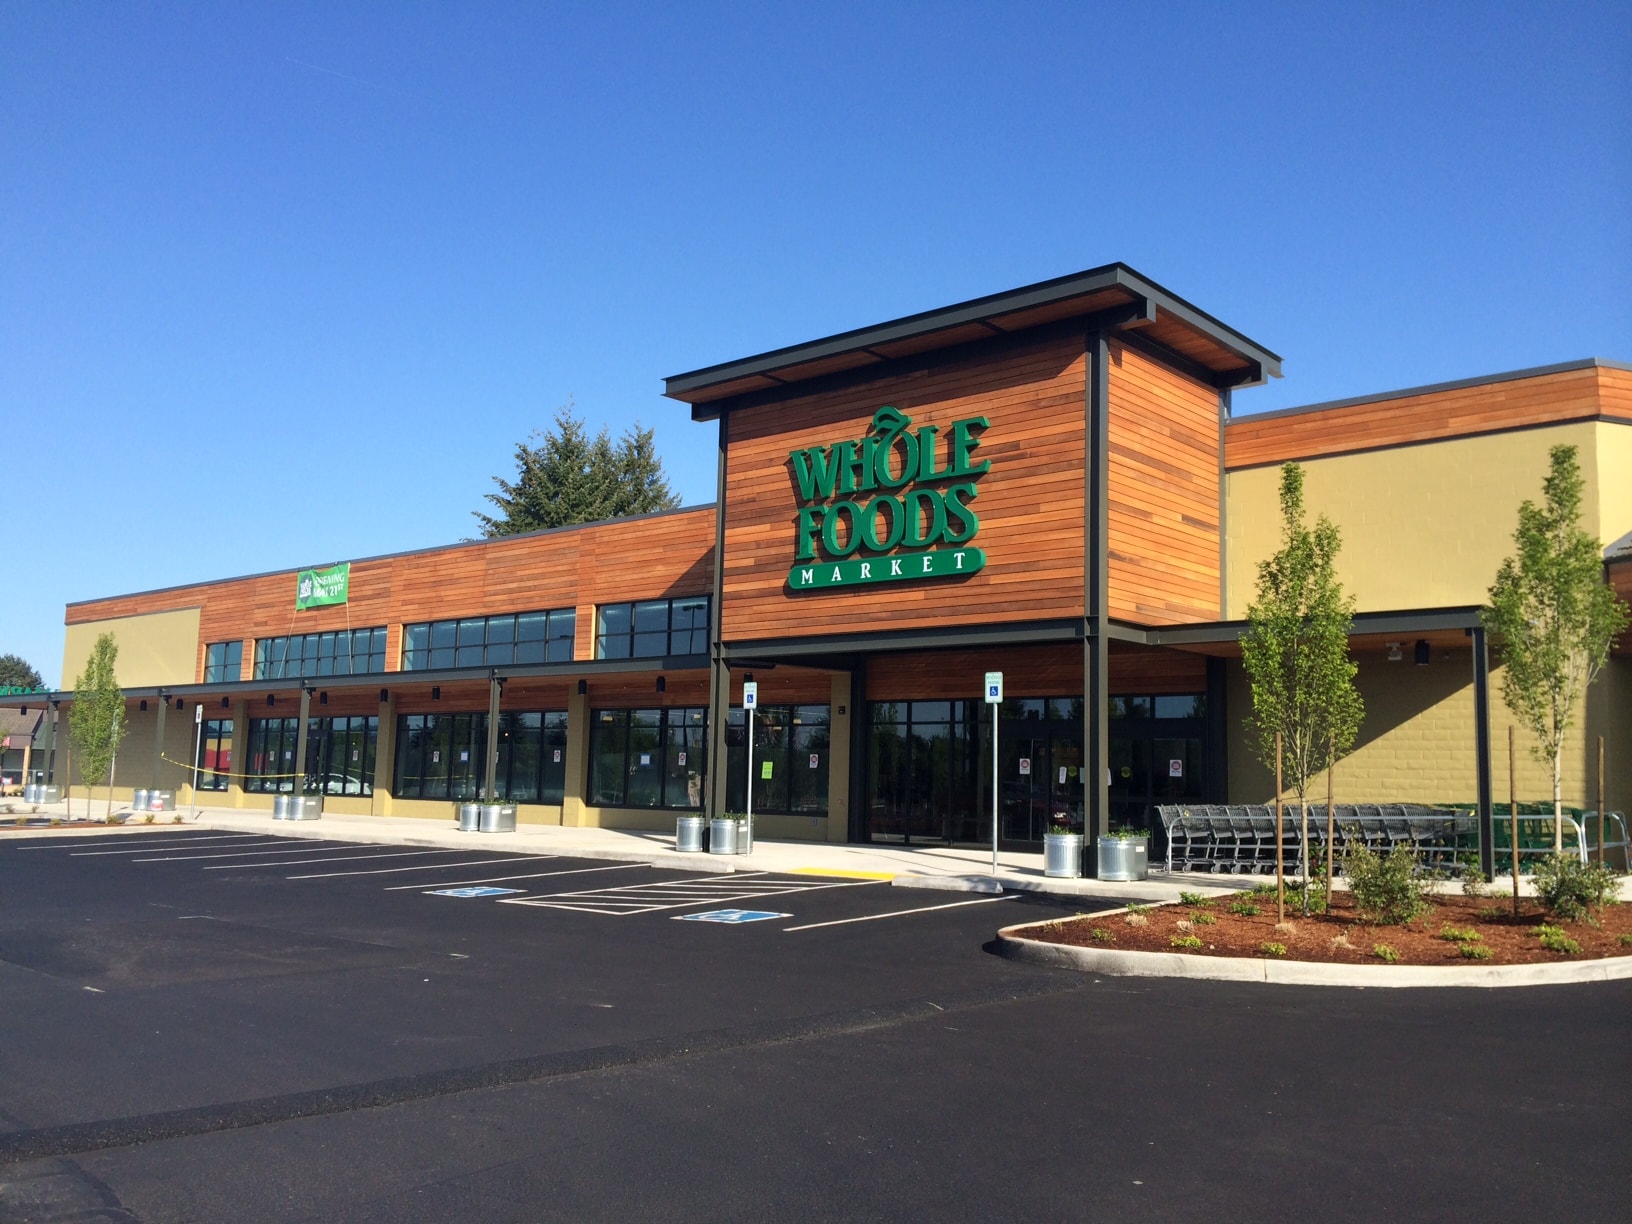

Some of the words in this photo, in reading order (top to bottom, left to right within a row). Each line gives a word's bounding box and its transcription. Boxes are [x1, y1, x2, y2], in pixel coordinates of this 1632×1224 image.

[790, 406, 992, 500] WHOLE
[796, 482, 979, 559] FOODS
[801, 552, 965, 584] MARKET
